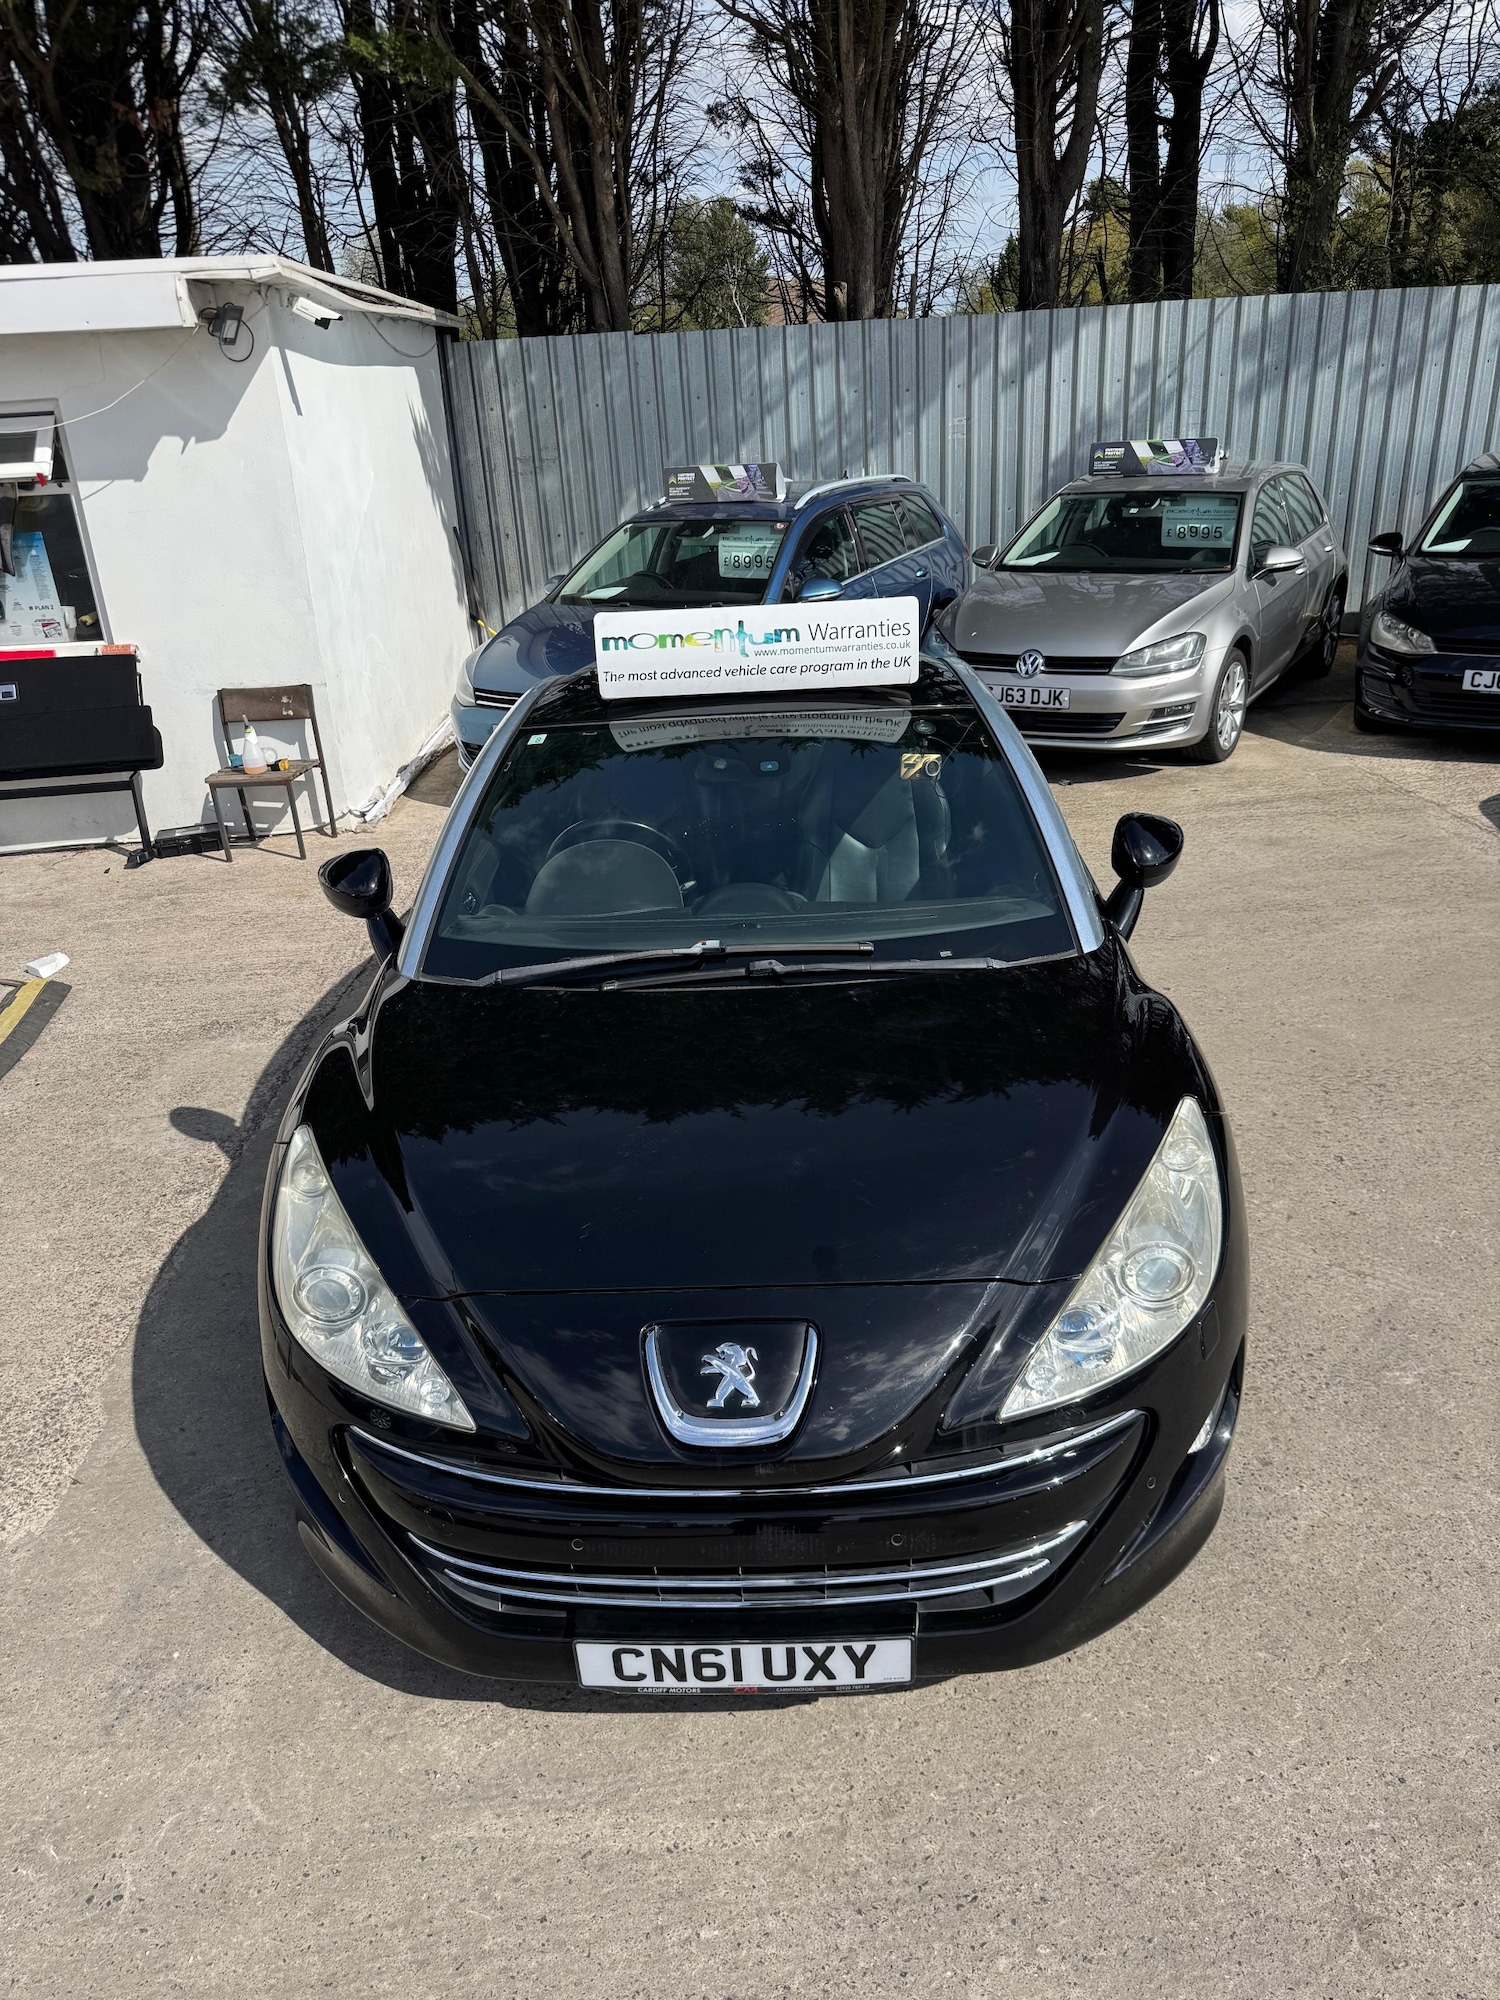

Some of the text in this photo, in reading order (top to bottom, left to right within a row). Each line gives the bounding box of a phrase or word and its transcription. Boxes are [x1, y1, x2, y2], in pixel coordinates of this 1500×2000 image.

[602, 618, 911, 657] momentum Warranties
[754, 640, 911, 657] www.momentumwarranties.co.uk
[603, 656, 912, 683] The most advanced vehicle care program in the UK
[1470, 672, 1500, 689] CJ
[1030, 688, 1064, 706] DJK
[612, 1644, 877, 1682] CN61 UXY
